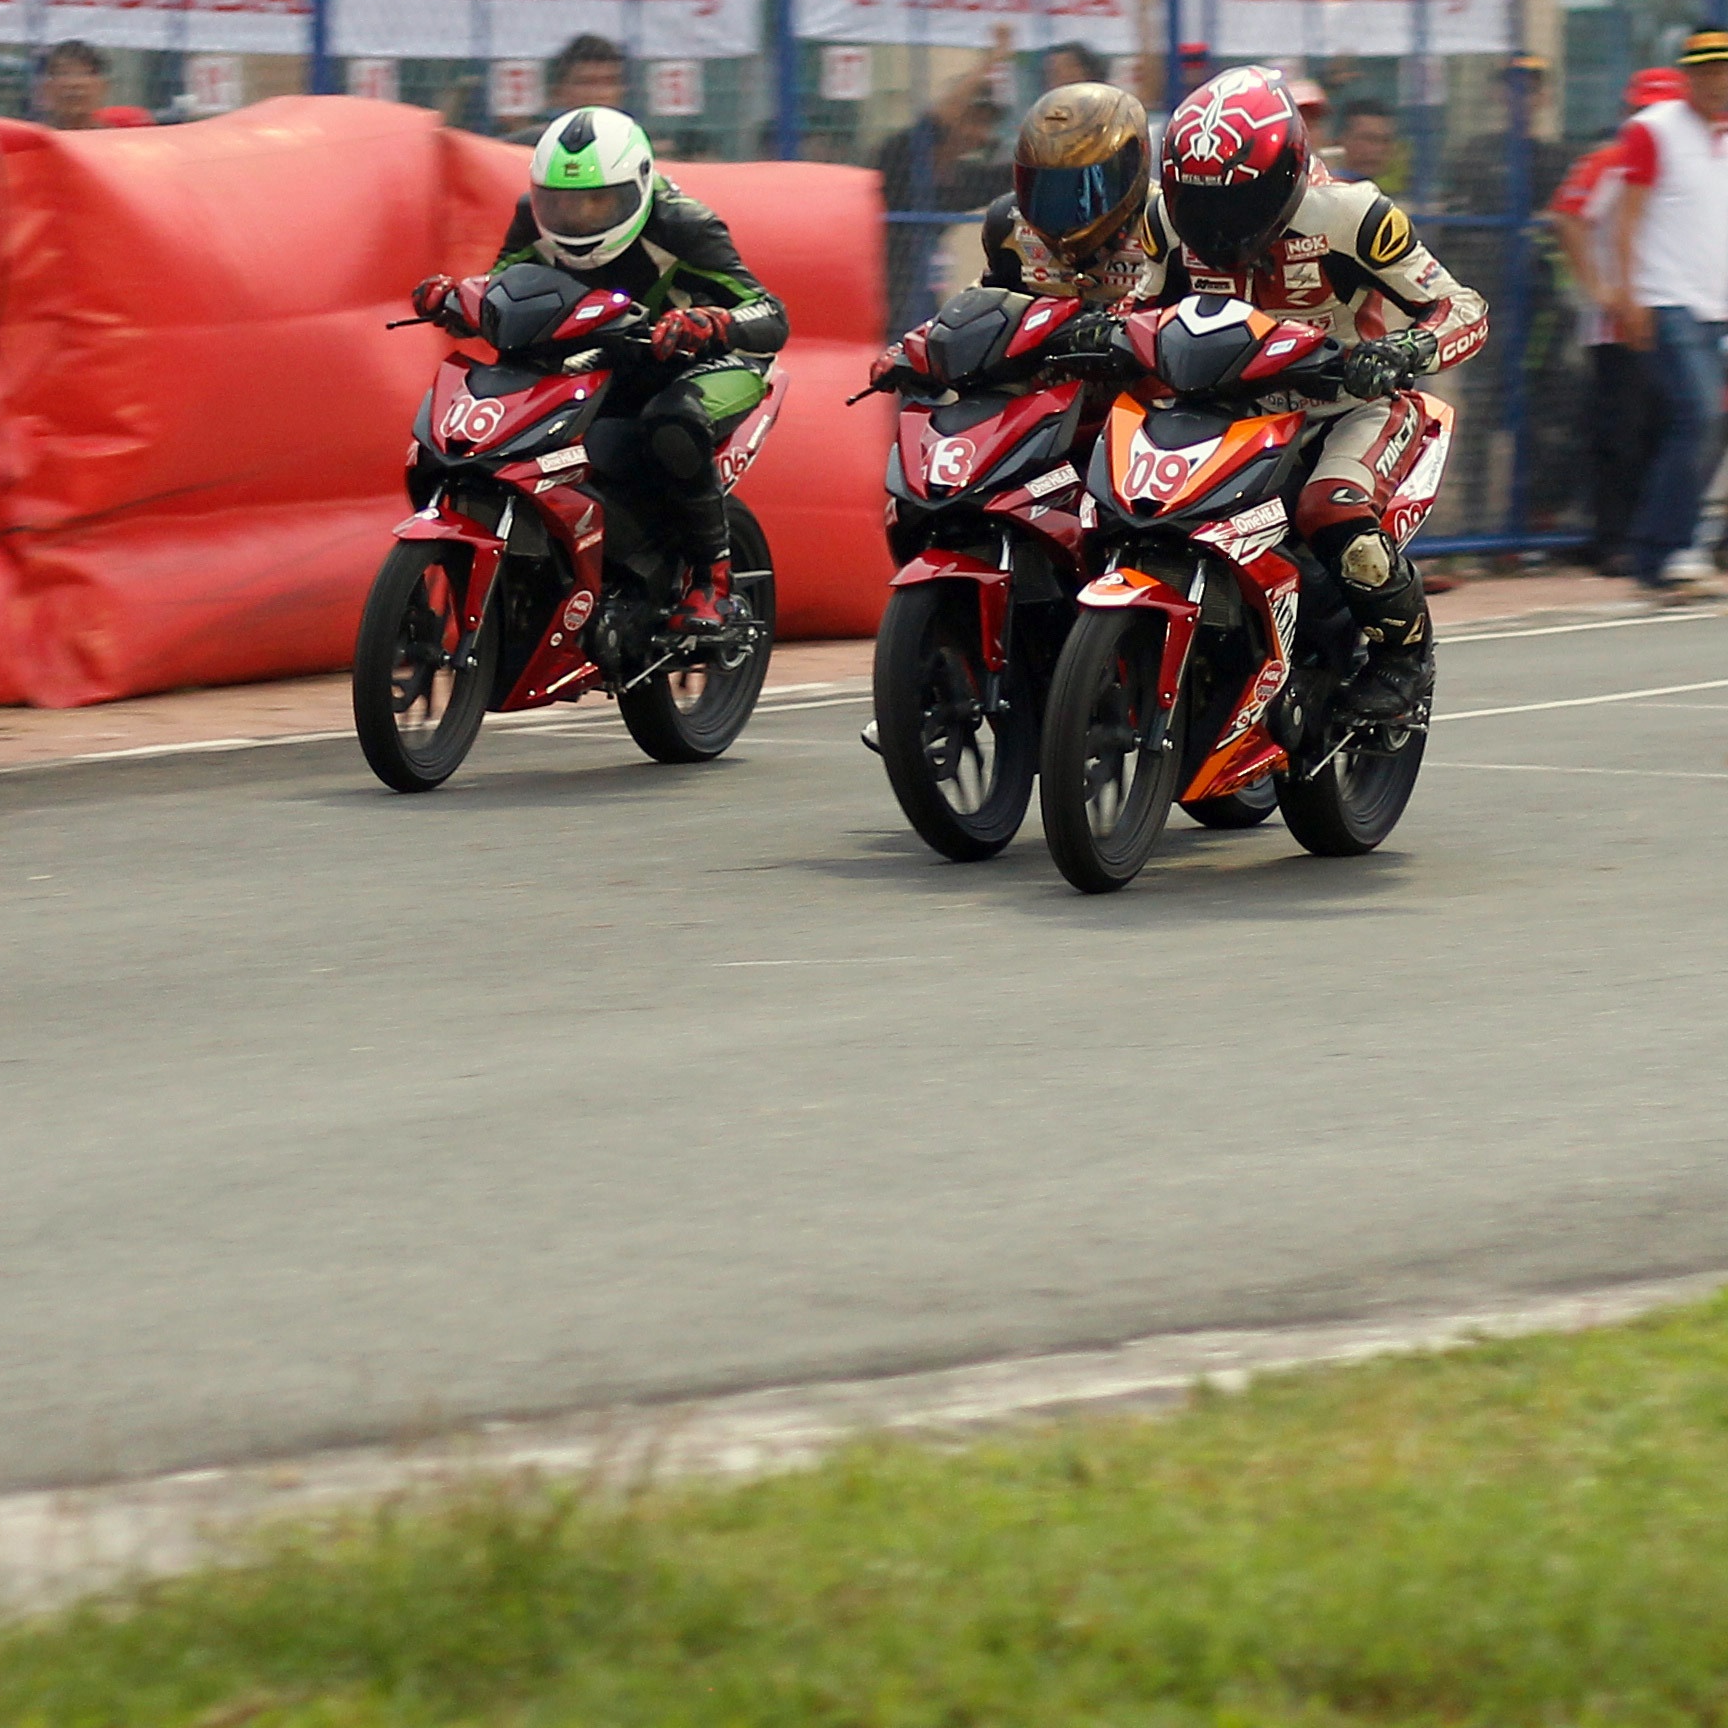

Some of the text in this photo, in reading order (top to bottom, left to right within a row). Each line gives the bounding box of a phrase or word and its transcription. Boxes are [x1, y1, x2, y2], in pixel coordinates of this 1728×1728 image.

[1286, 234, 1326, 255] NGK
[441, 394, 505, 443] 06
[1124, 450, 1190, 502] 09
